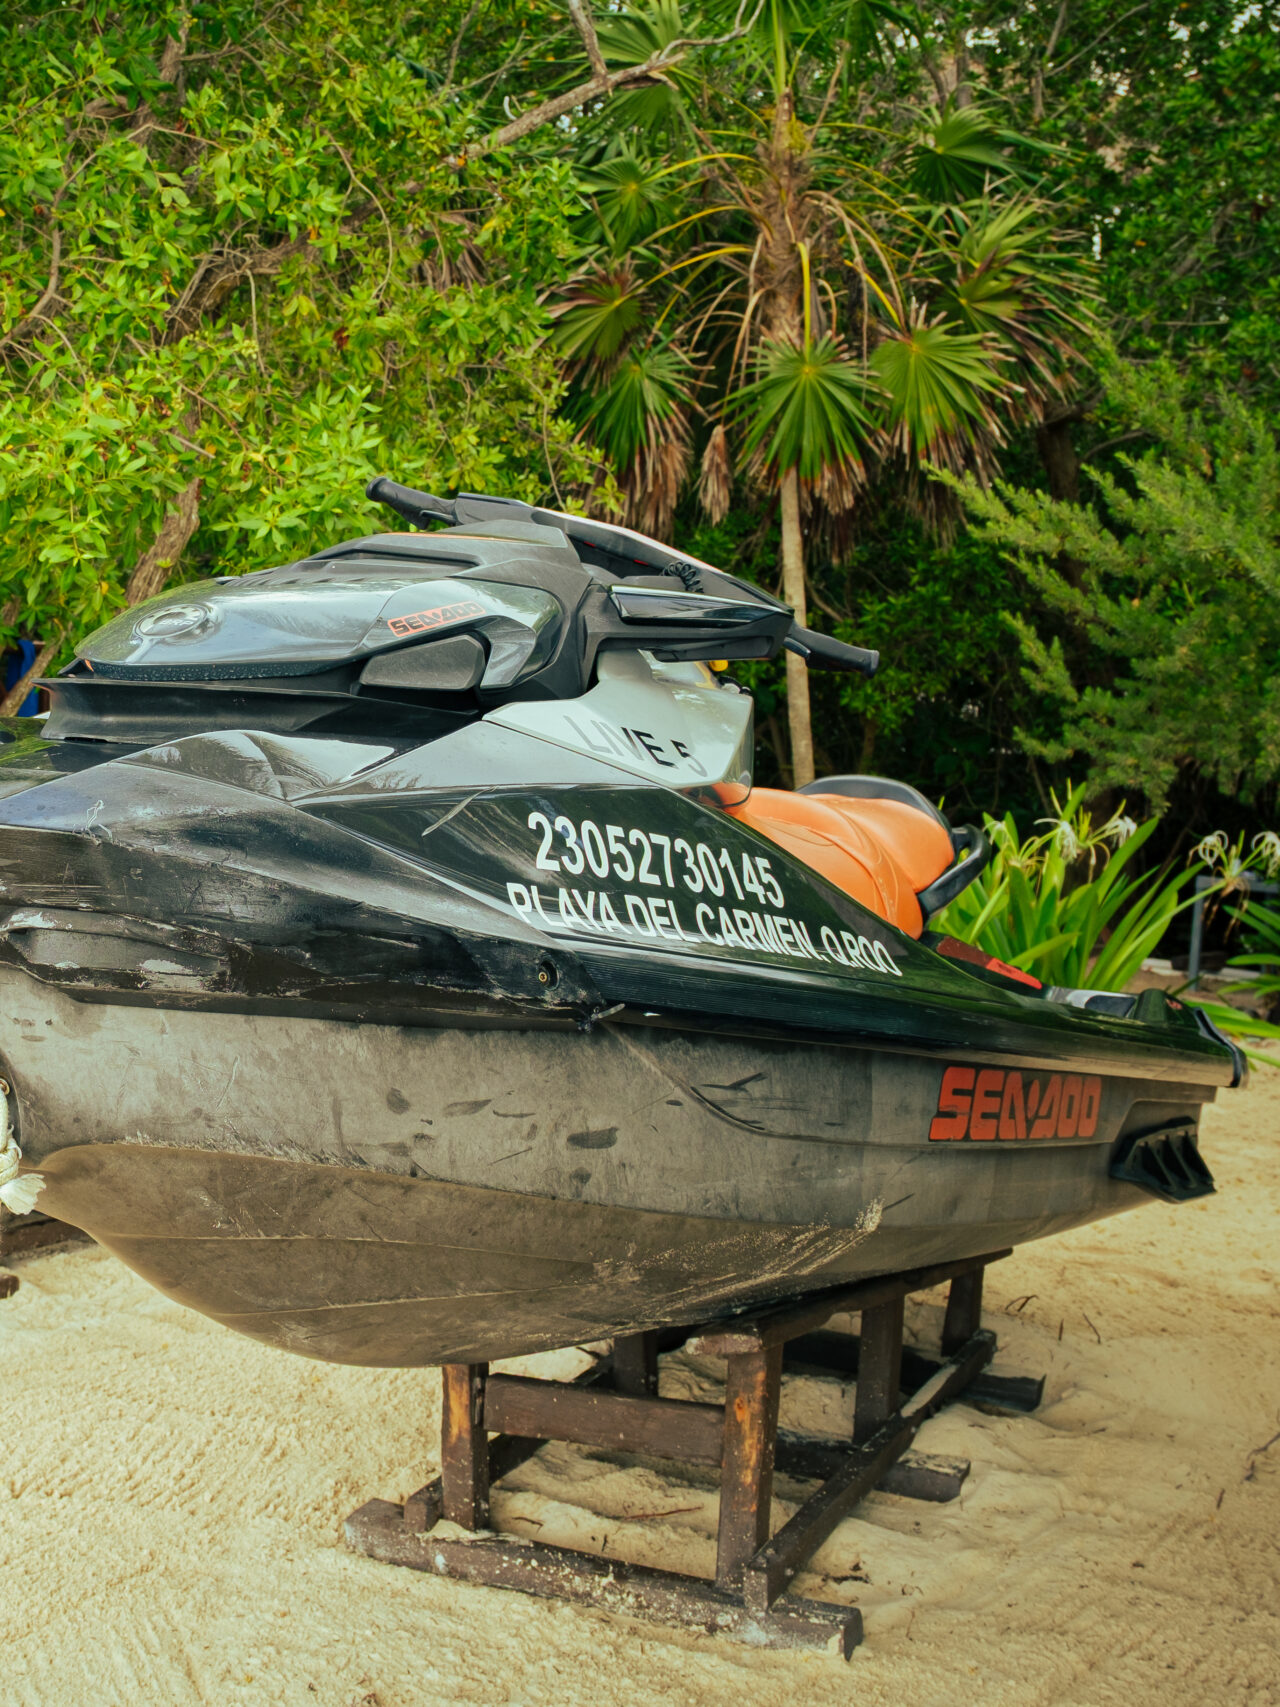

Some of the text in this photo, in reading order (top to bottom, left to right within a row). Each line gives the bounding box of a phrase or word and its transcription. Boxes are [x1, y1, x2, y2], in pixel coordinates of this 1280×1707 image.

[563, 715, 708, 777] LIVE 5
[527, 812, 785, 909] 23052730145
[506, 882, 631, 935] PLAYA
[625, 895, 702, 943] DEL
[820, 925, 903, 977] Q.ROO
